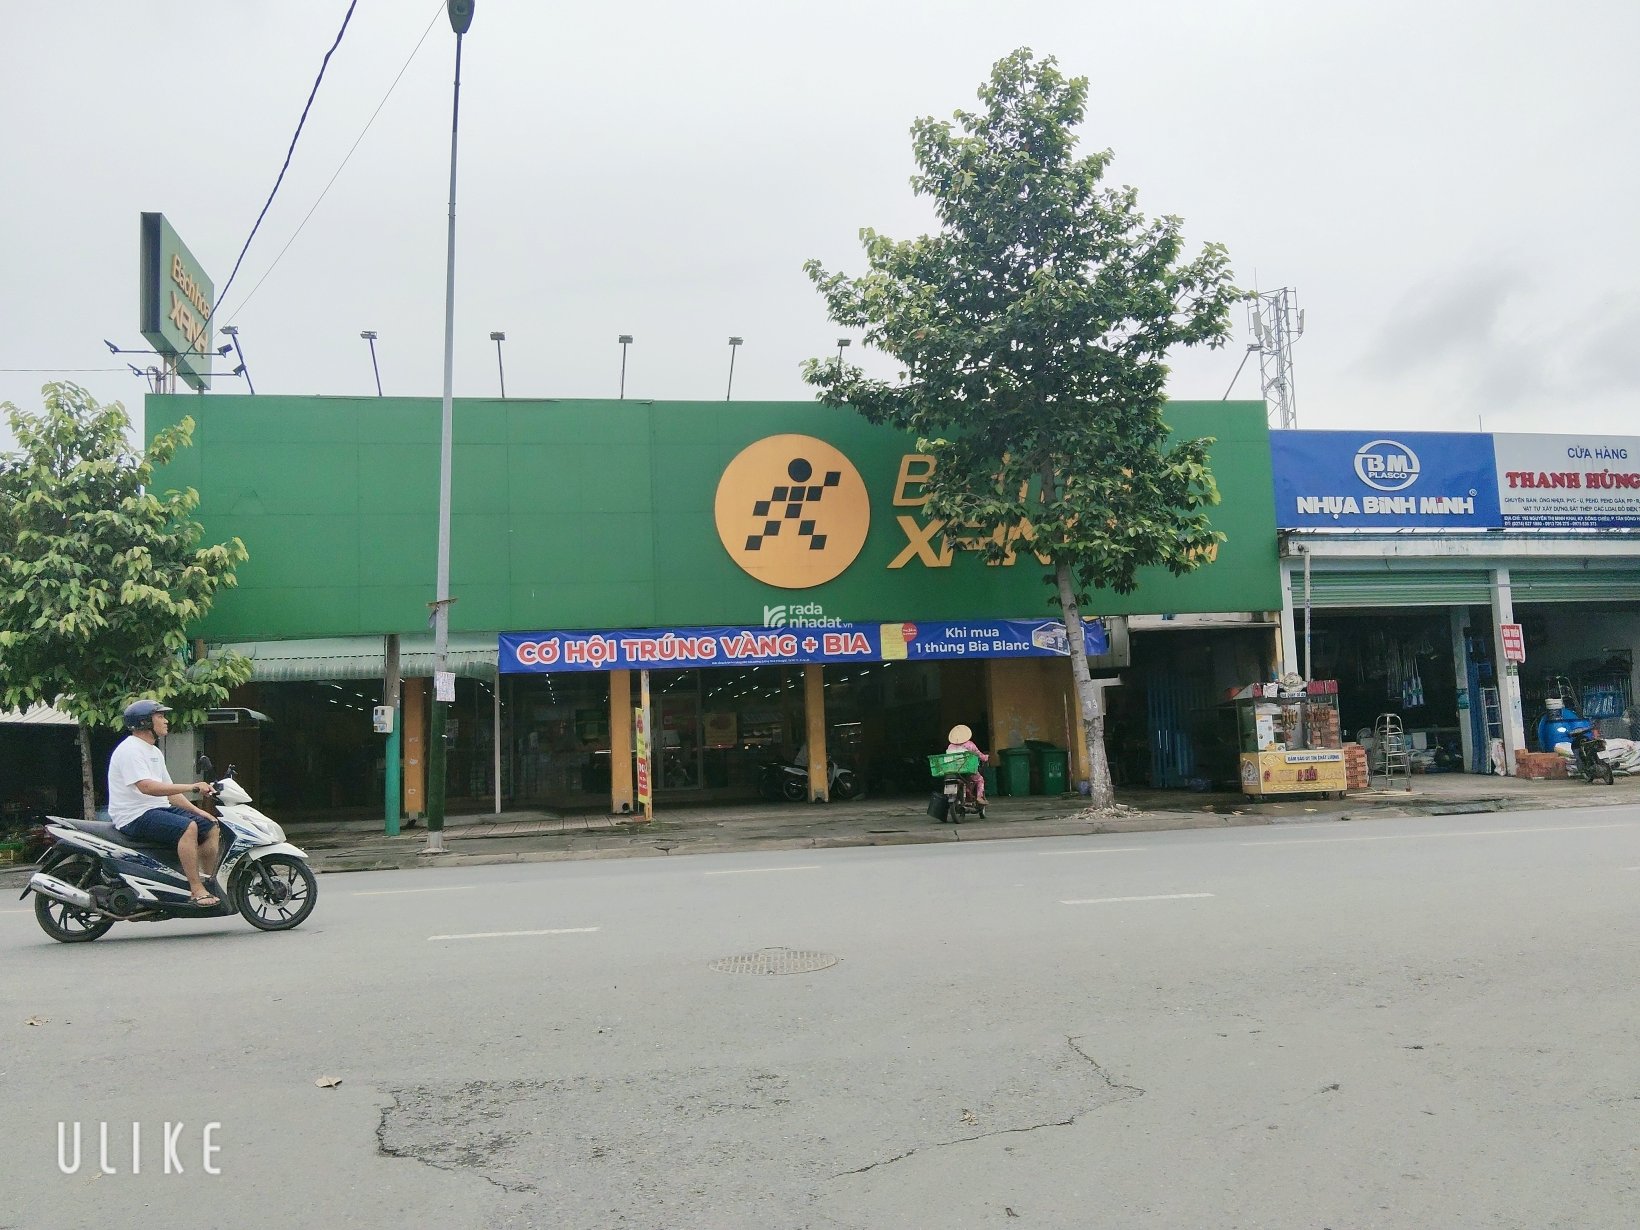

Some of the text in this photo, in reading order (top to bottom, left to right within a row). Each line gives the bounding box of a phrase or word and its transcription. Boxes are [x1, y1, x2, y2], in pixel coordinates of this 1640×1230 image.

[169, 290, 208, 358] XANH
[1567, 445, 1628, 460] CỬA HÀNG
[1368, 471, 1408, 479] PLASCO
[1505, 468, 1640, 489] THANH HÙNG
[946, 627, 999, 638] Khi mua
[517, 631, 872, 668] CƠ HỘI TRÚNG VÀNG + BIA
[916, 641, 1029, 654] 1 thùng Bia Blanc
